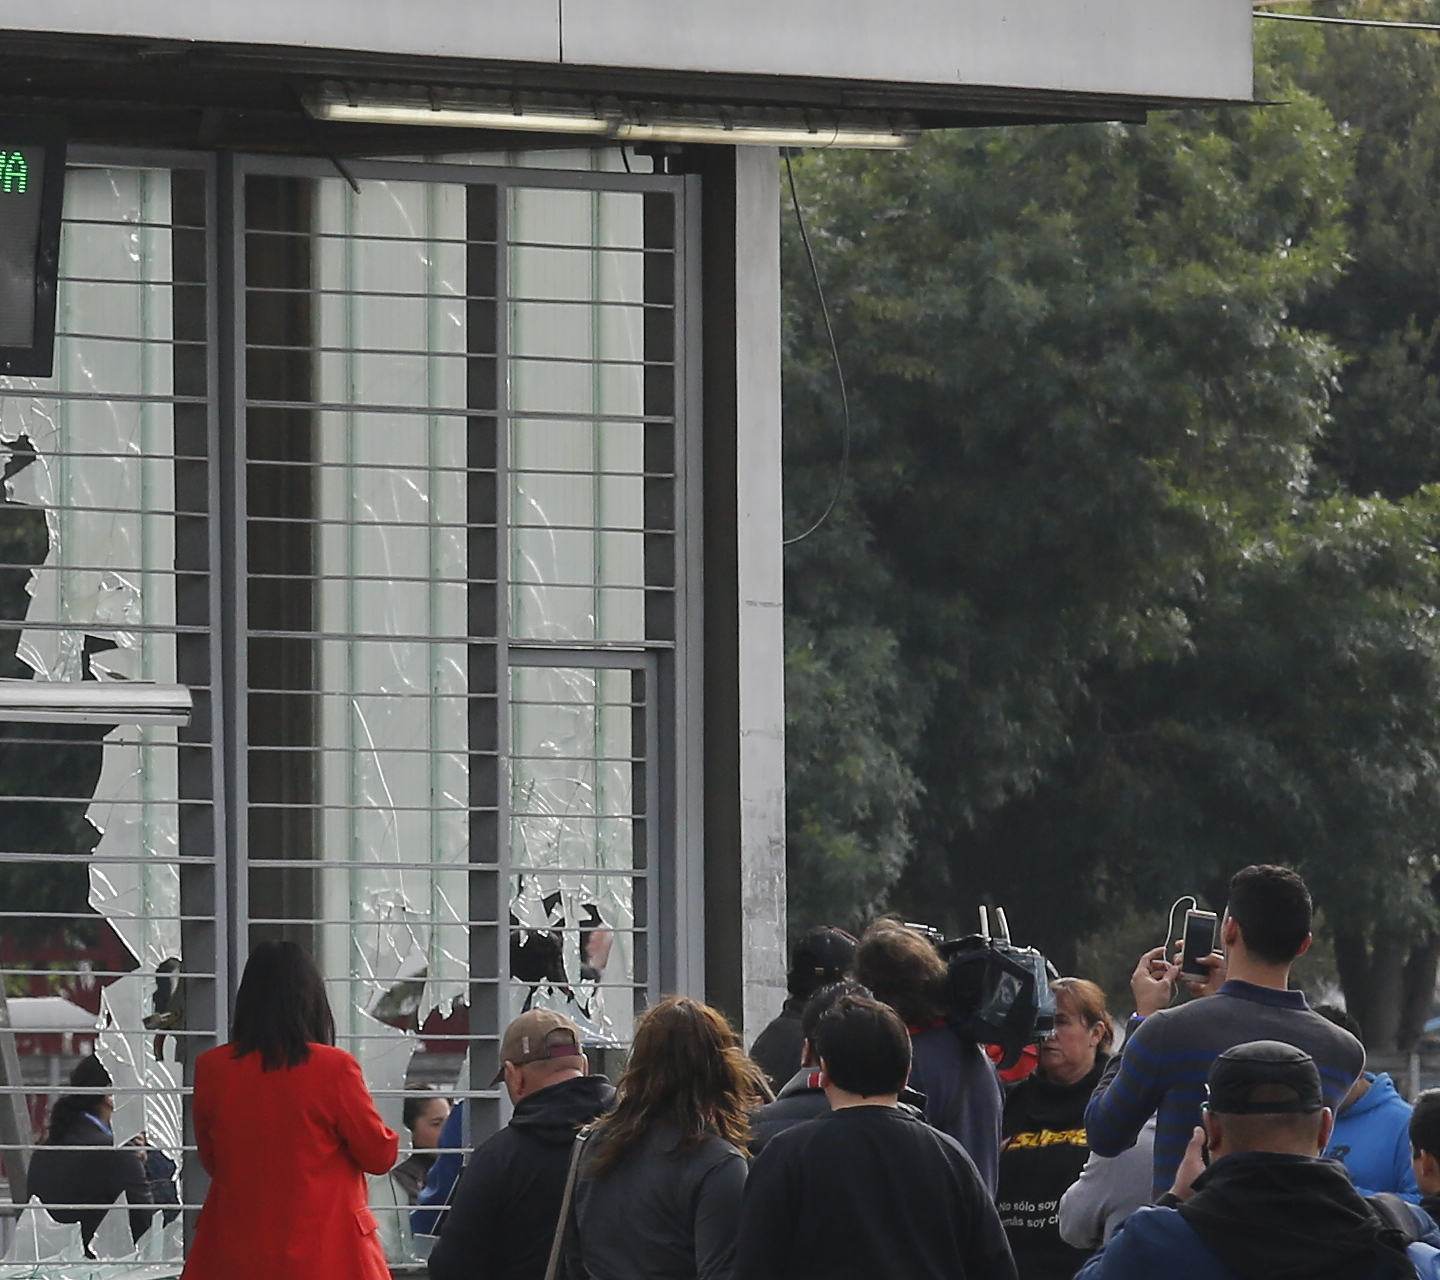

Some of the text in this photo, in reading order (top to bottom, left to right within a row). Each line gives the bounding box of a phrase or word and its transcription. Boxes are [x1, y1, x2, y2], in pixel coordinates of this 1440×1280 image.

[1013, 1200, 1036, 1212] sólo
[1037, 1200, 1058, 1211] soy
[1026, 1218, 1046, 1228] soy
